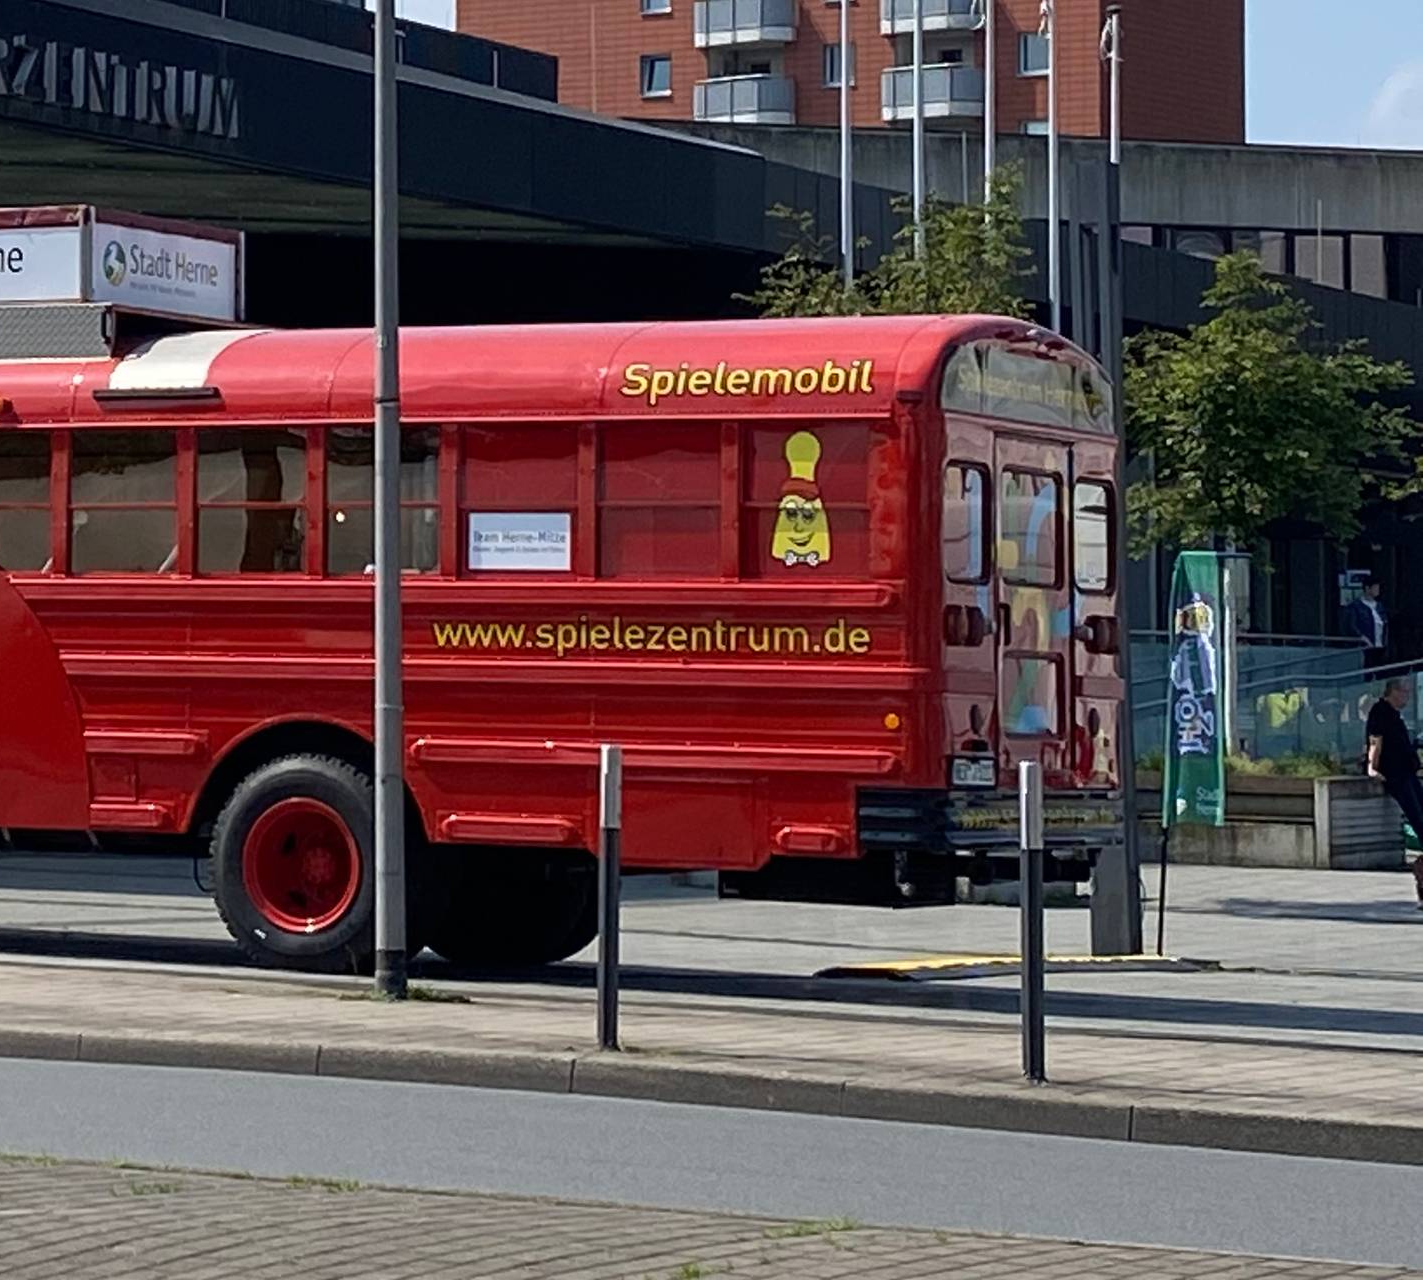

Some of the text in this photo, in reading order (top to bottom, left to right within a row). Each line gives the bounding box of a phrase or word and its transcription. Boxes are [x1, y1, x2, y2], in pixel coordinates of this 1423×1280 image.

[129, 244, 218, 287] Stadt Herne
[619, 358, 875, 407] Spielemobil
[432, 614, 871, 658] www.spielezentrum.de
